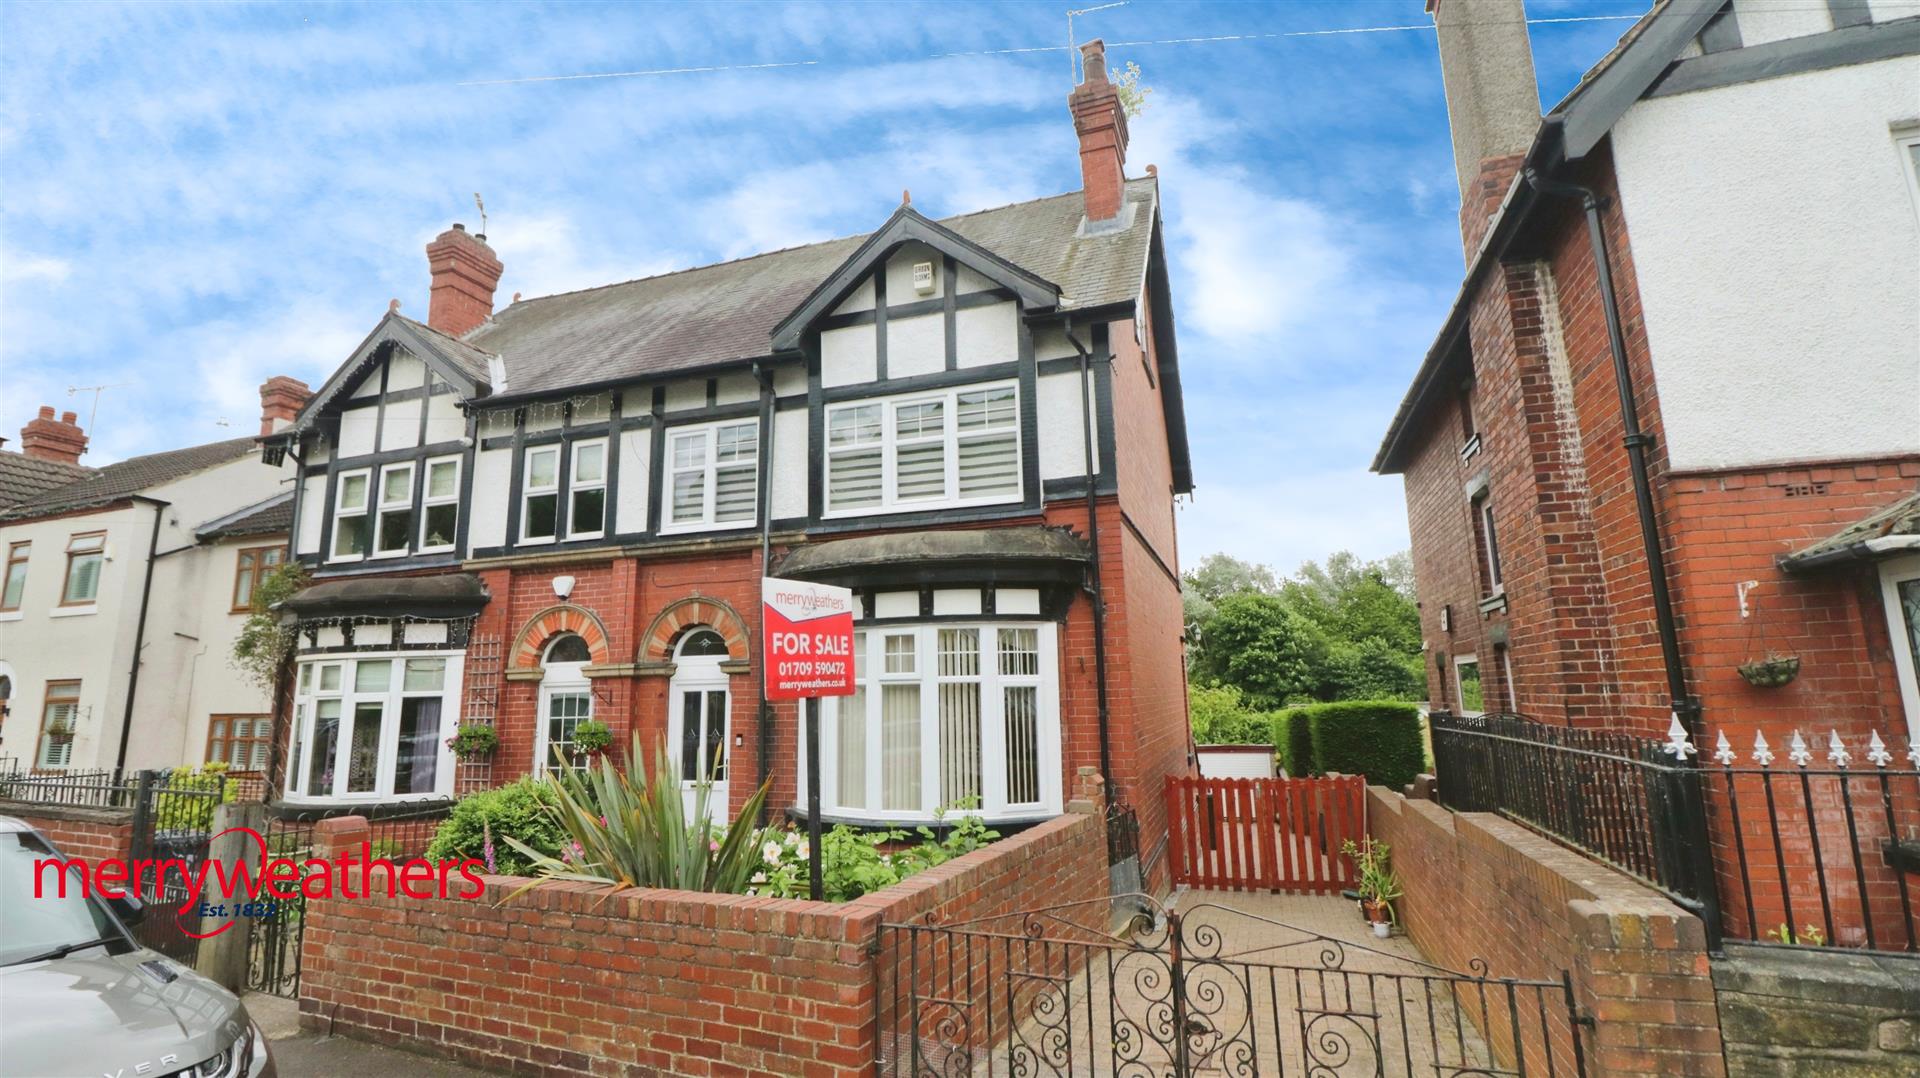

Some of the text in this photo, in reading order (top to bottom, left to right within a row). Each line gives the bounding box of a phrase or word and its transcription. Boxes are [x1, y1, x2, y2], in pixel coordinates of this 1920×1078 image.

[776, 591, 844, 610] merryweathers
[772, 632, 849, 655] FOR SALE
[779, 662, 845, 676] 01709 590472
[779, 678, 846, 691] merryweathers.co.uk
